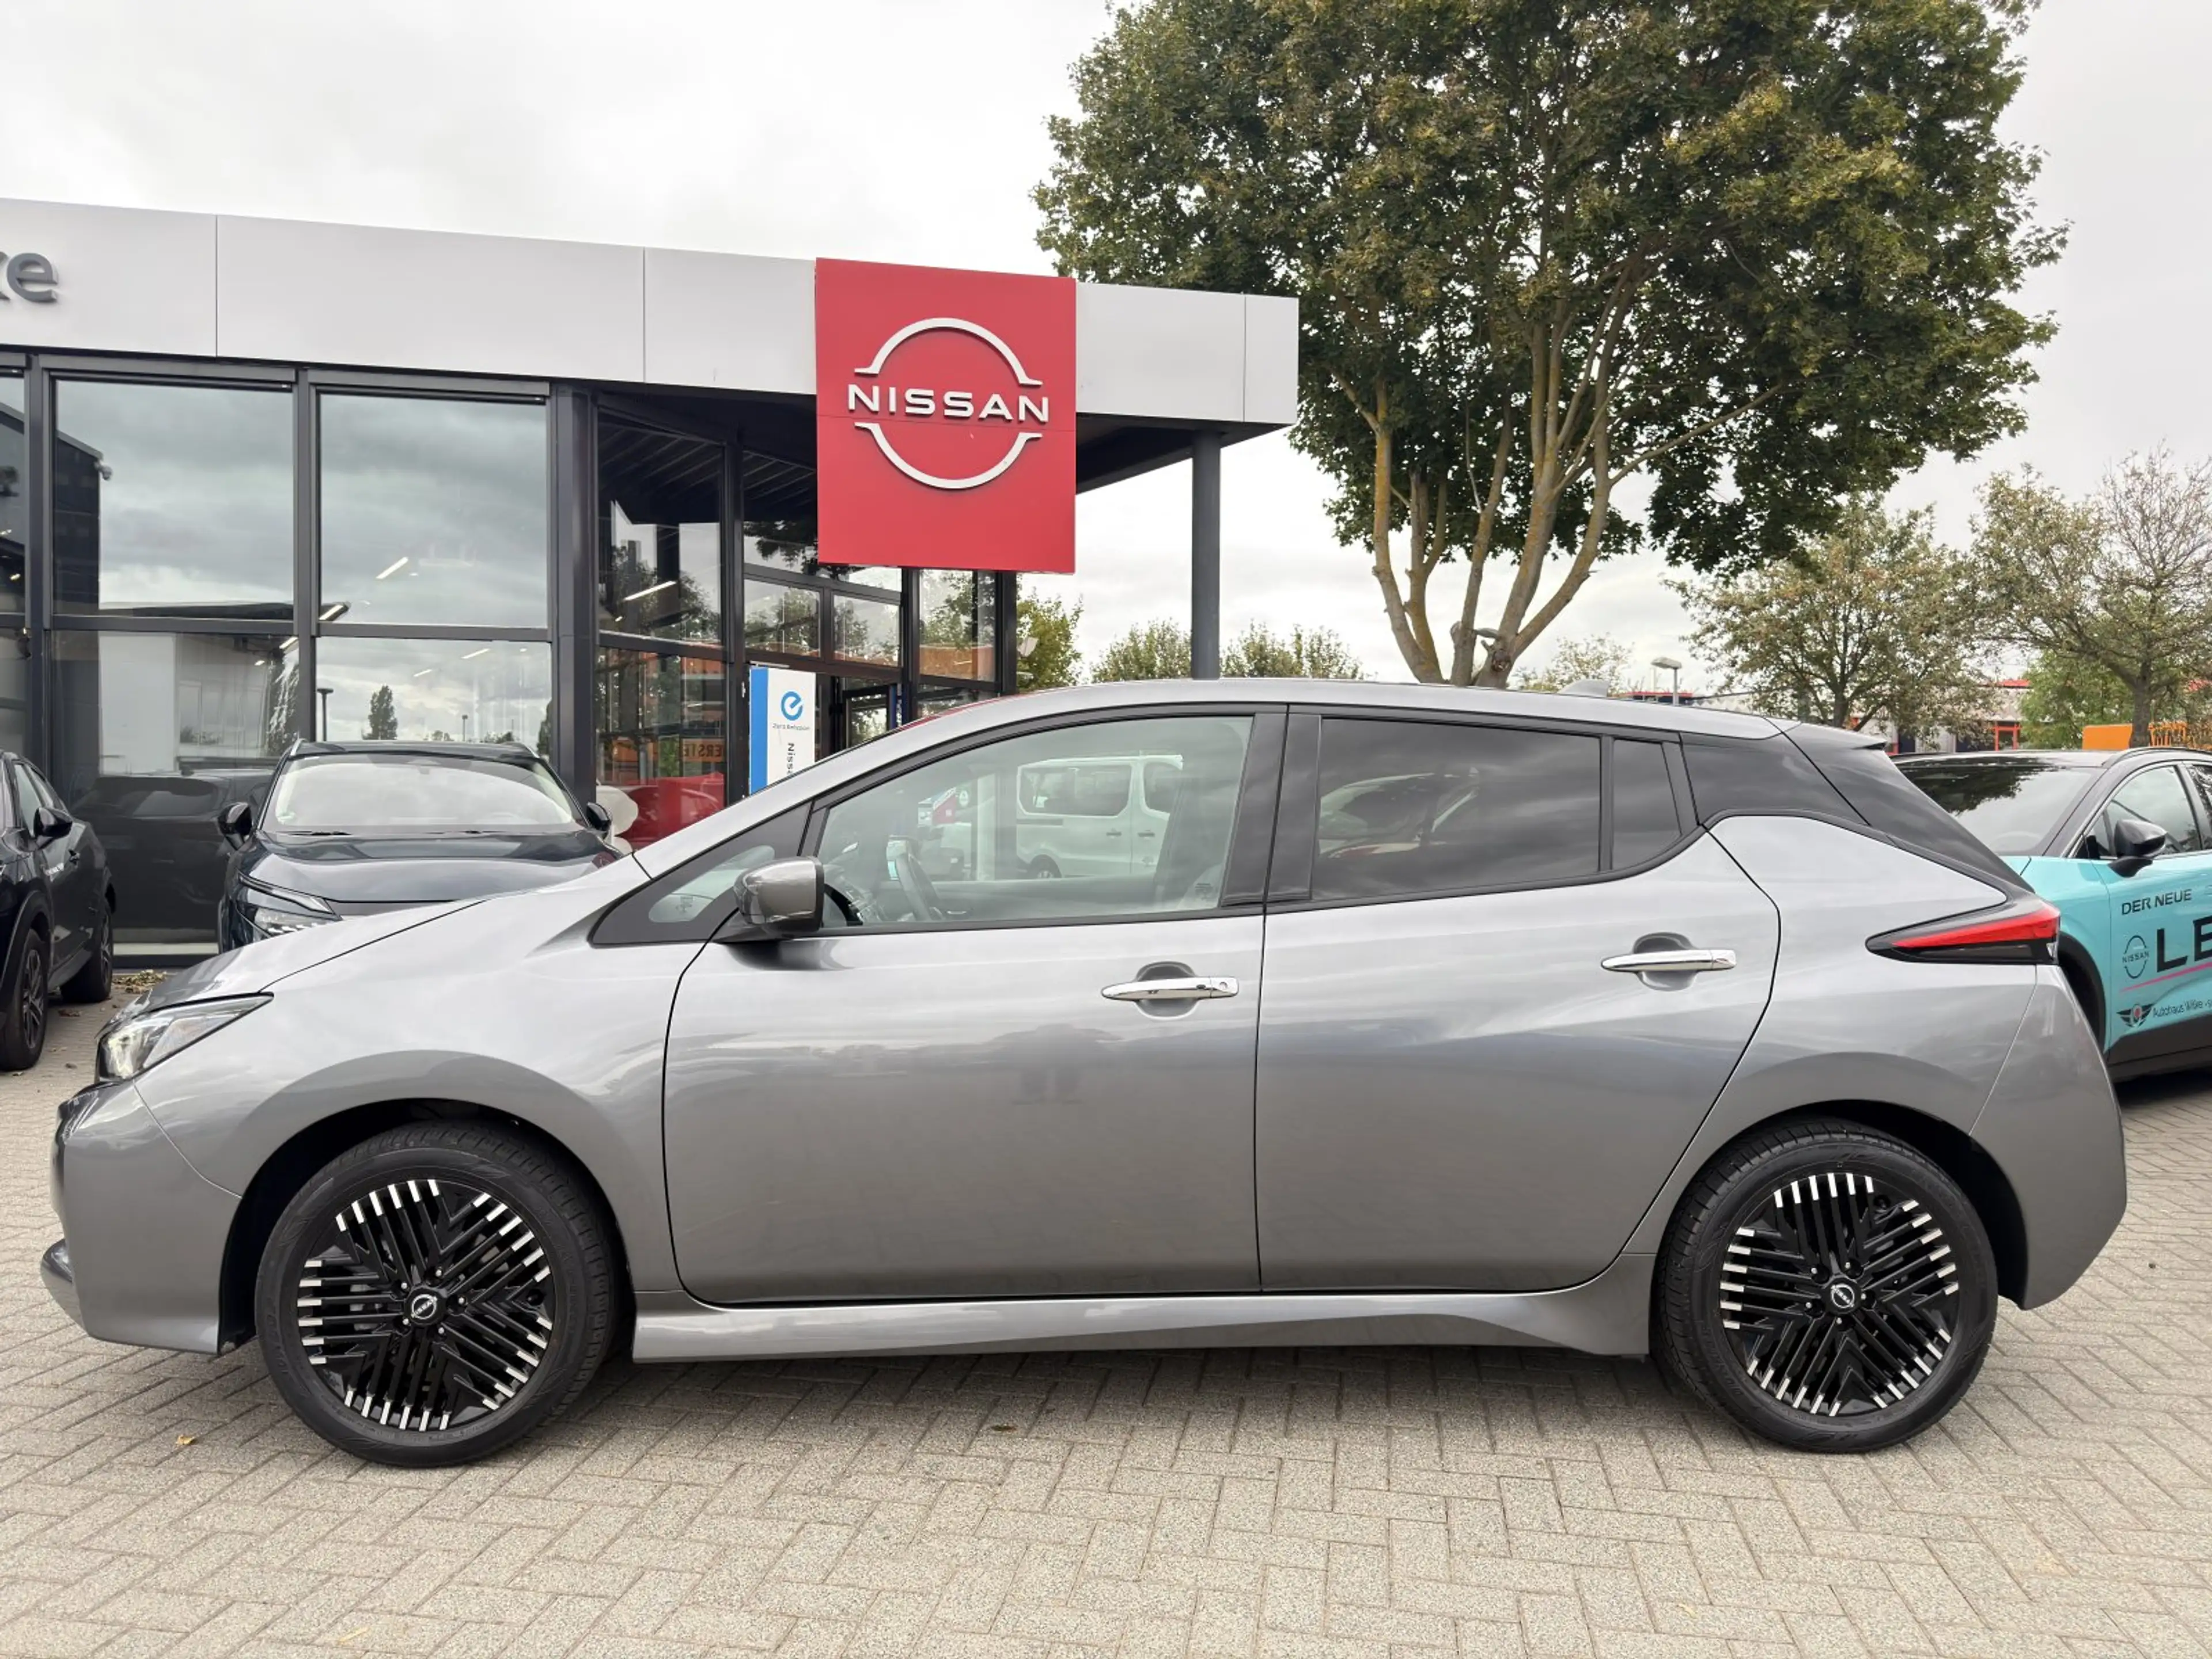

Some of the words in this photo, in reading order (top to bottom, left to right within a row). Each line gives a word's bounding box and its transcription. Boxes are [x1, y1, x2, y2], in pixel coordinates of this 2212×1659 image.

[0, 251, 58, 303] e
[848, 384, 1049, 423] NISSAN
[2122, 897, 2151, 915] DER
[2154, 889, 2192, 907] NEUE
[2122, 950, 2149, 964] NISSAN
